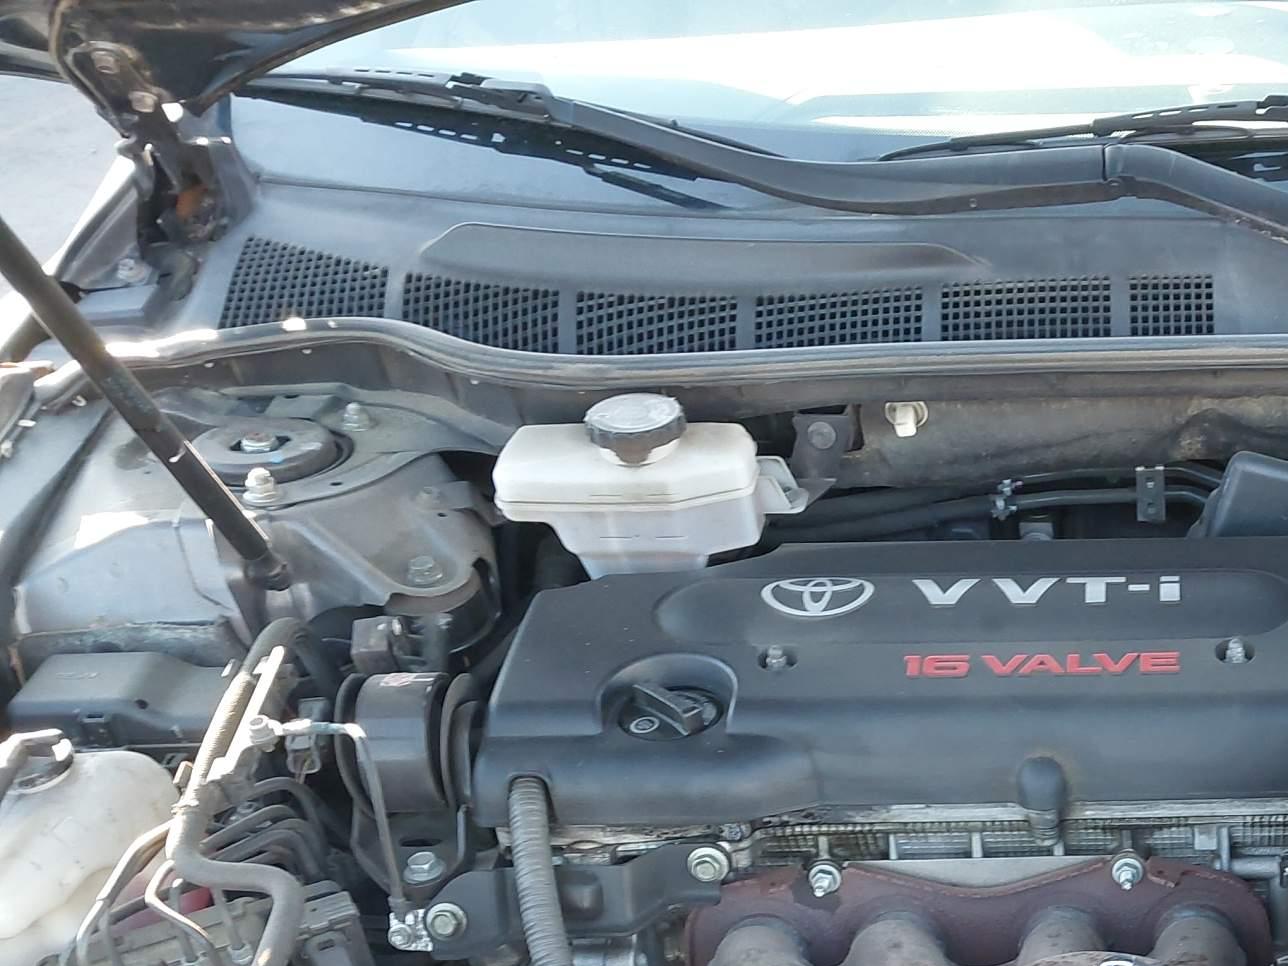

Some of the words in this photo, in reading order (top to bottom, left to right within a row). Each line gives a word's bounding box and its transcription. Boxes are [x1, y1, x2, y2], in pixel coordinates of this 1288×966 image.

[911, 575, 1181, 606] VVT-i
[903, 654, 971, 679] 16
[981, 651, 1181, 678] VALVE
